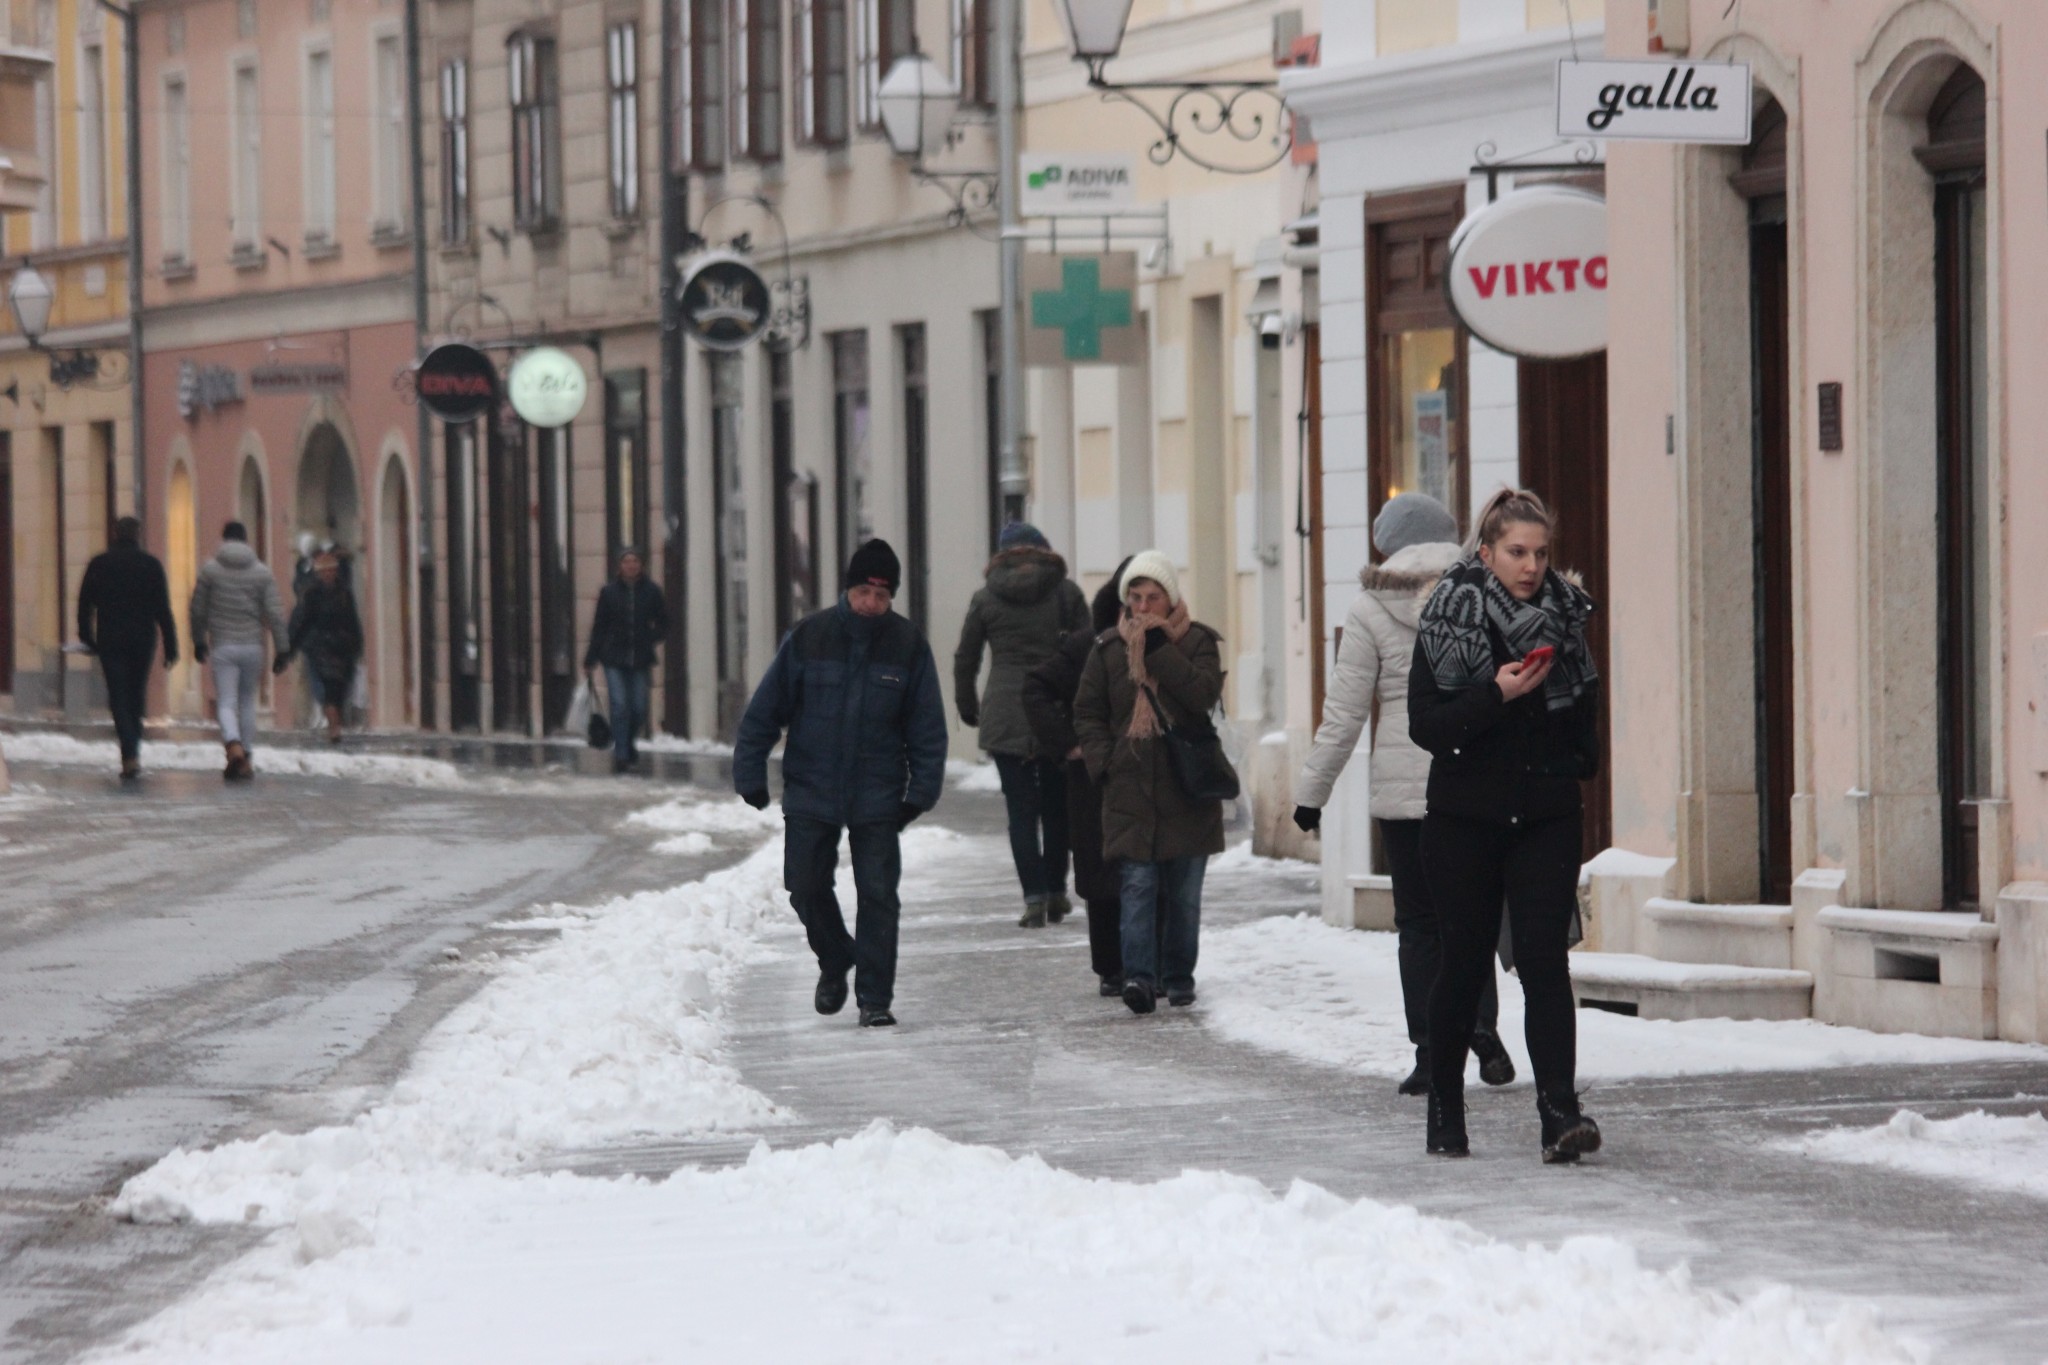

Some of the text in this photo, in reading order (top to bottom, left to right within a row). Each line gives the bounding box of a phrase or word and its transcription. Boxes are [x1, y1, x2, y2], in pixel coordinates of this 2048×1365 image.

[1587, 66, 1718, 130] galla
[1067, 168, 1128, 186] ADIVA
[1468, 255, 1607, 299] VIKTO
